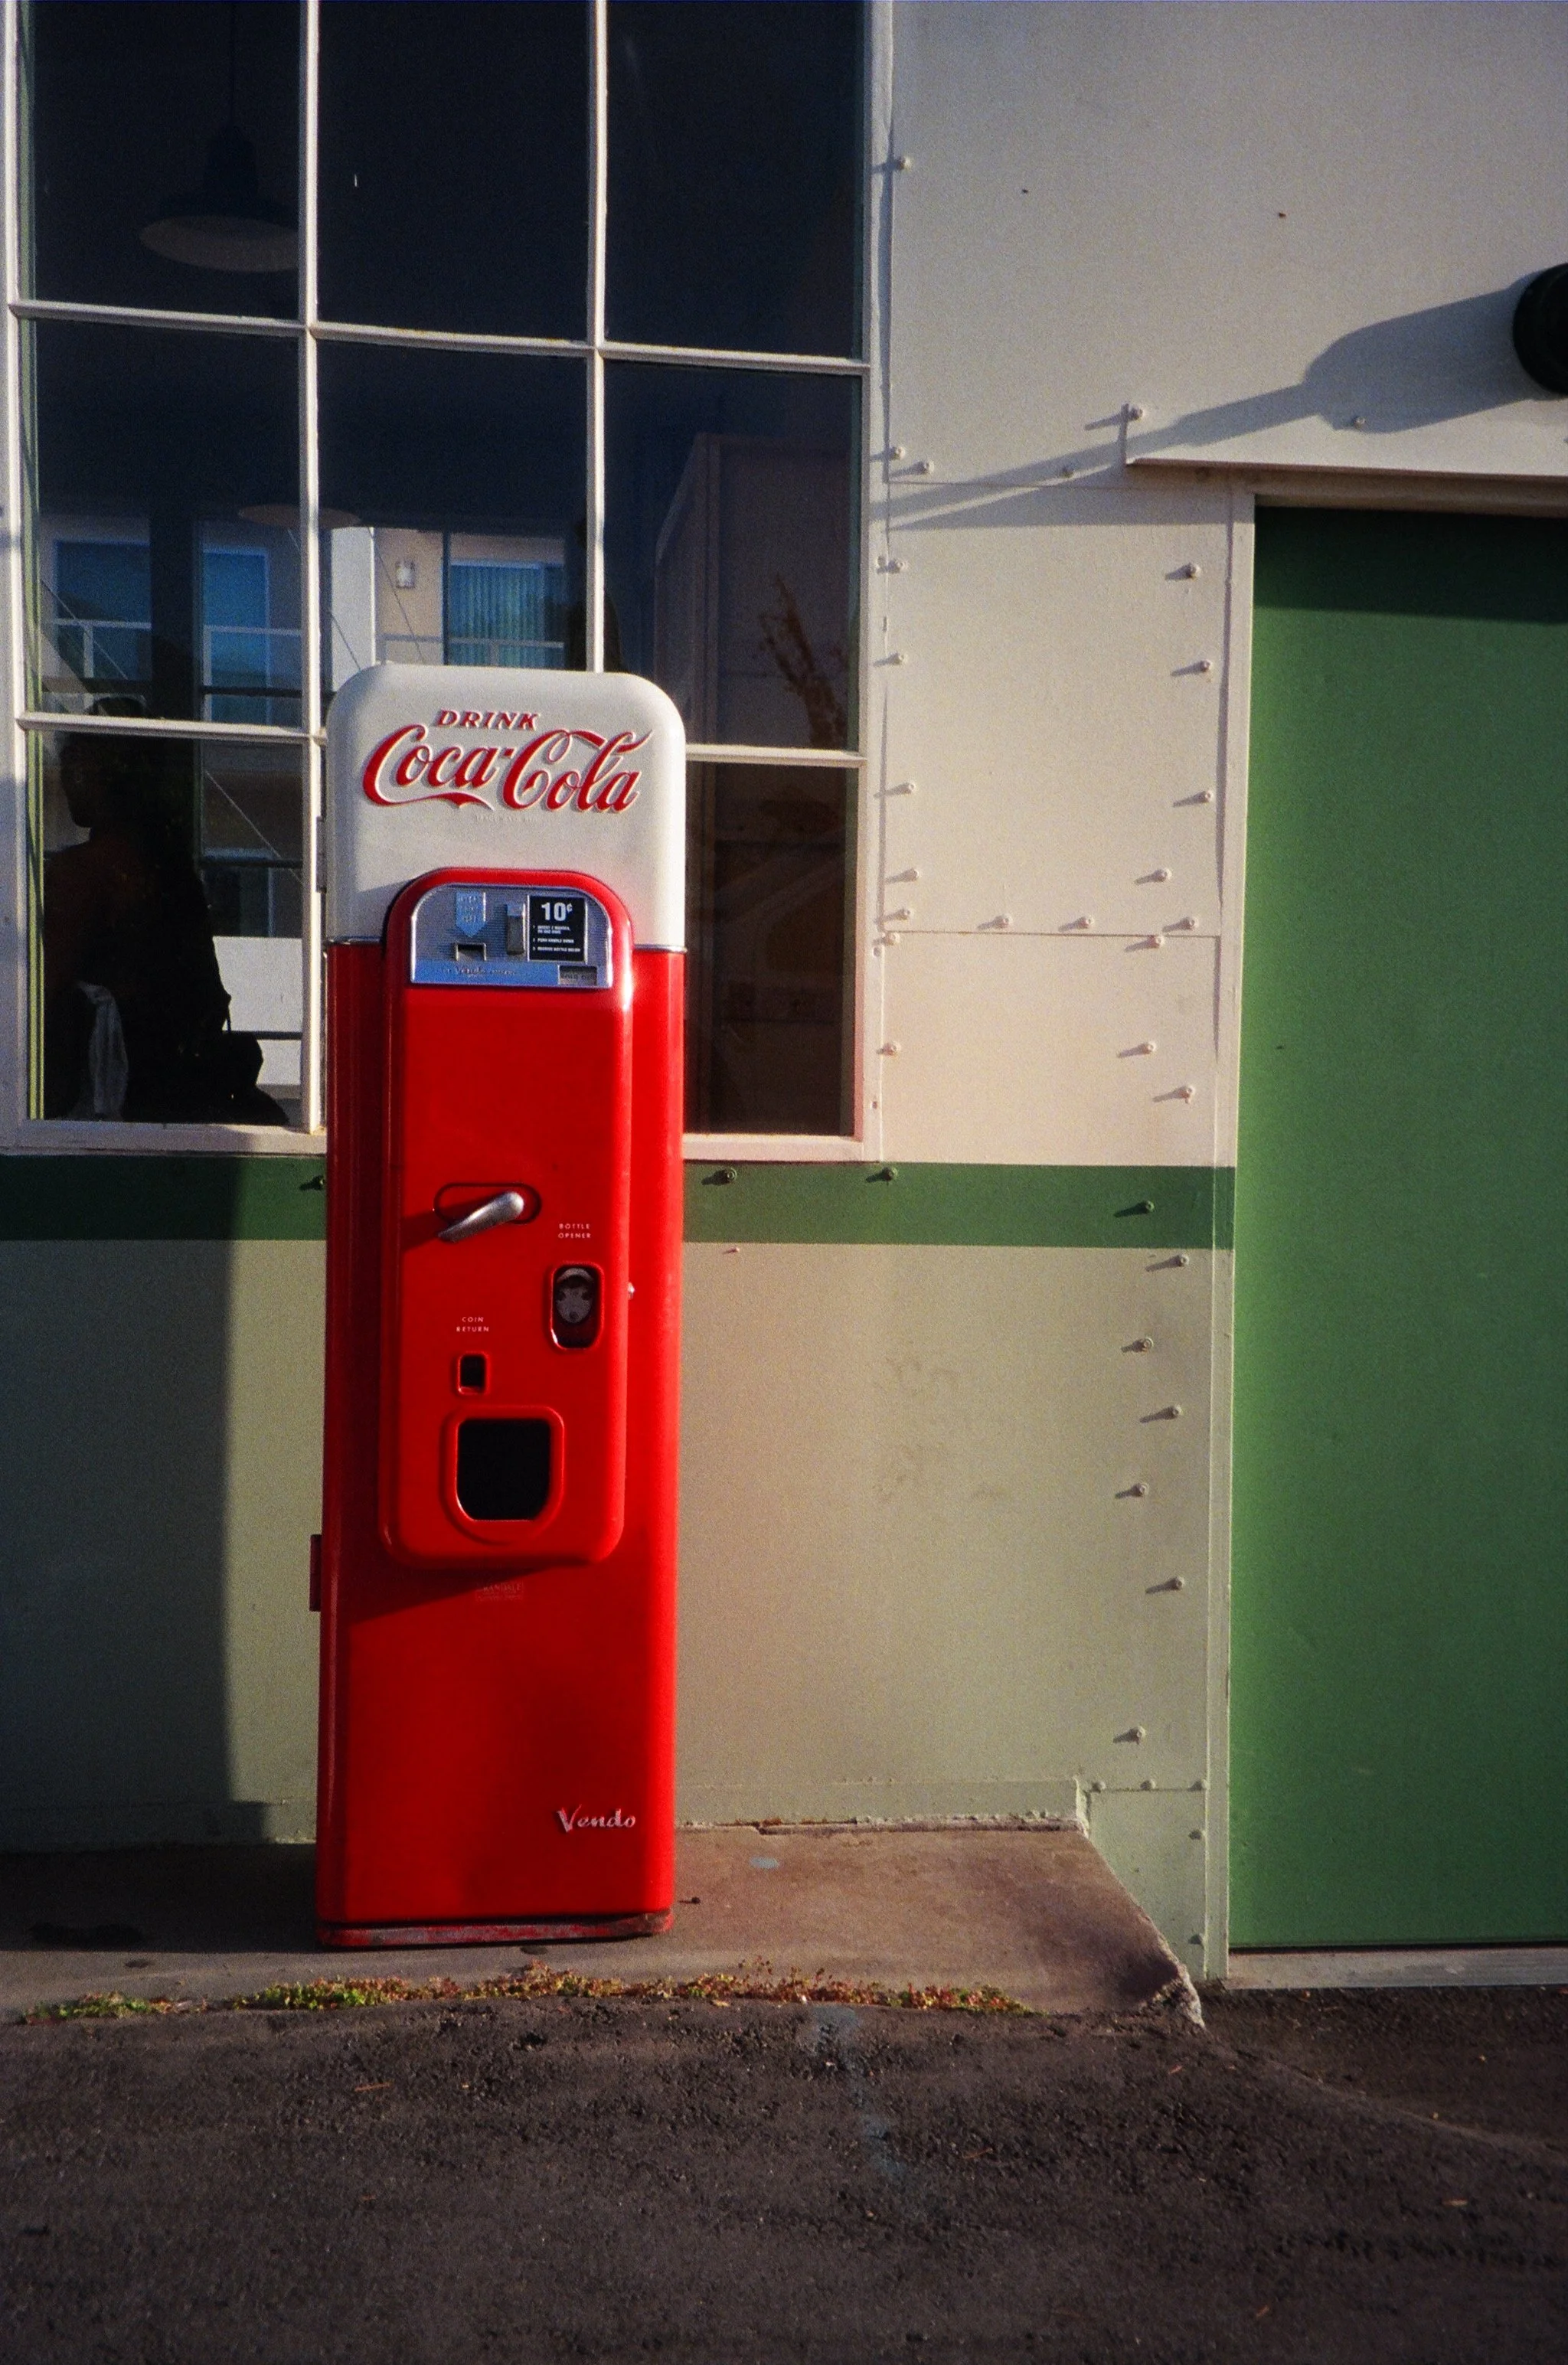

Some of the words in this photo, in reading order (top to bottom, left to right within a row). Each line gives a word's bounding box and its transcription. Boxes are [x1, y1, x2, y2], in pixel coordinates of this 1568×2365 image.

[436, 708, 539, 731] DRINK
[362, 724, 654, 813] Coca-Cola
[557, 1803, 637, 1834] Vendo
